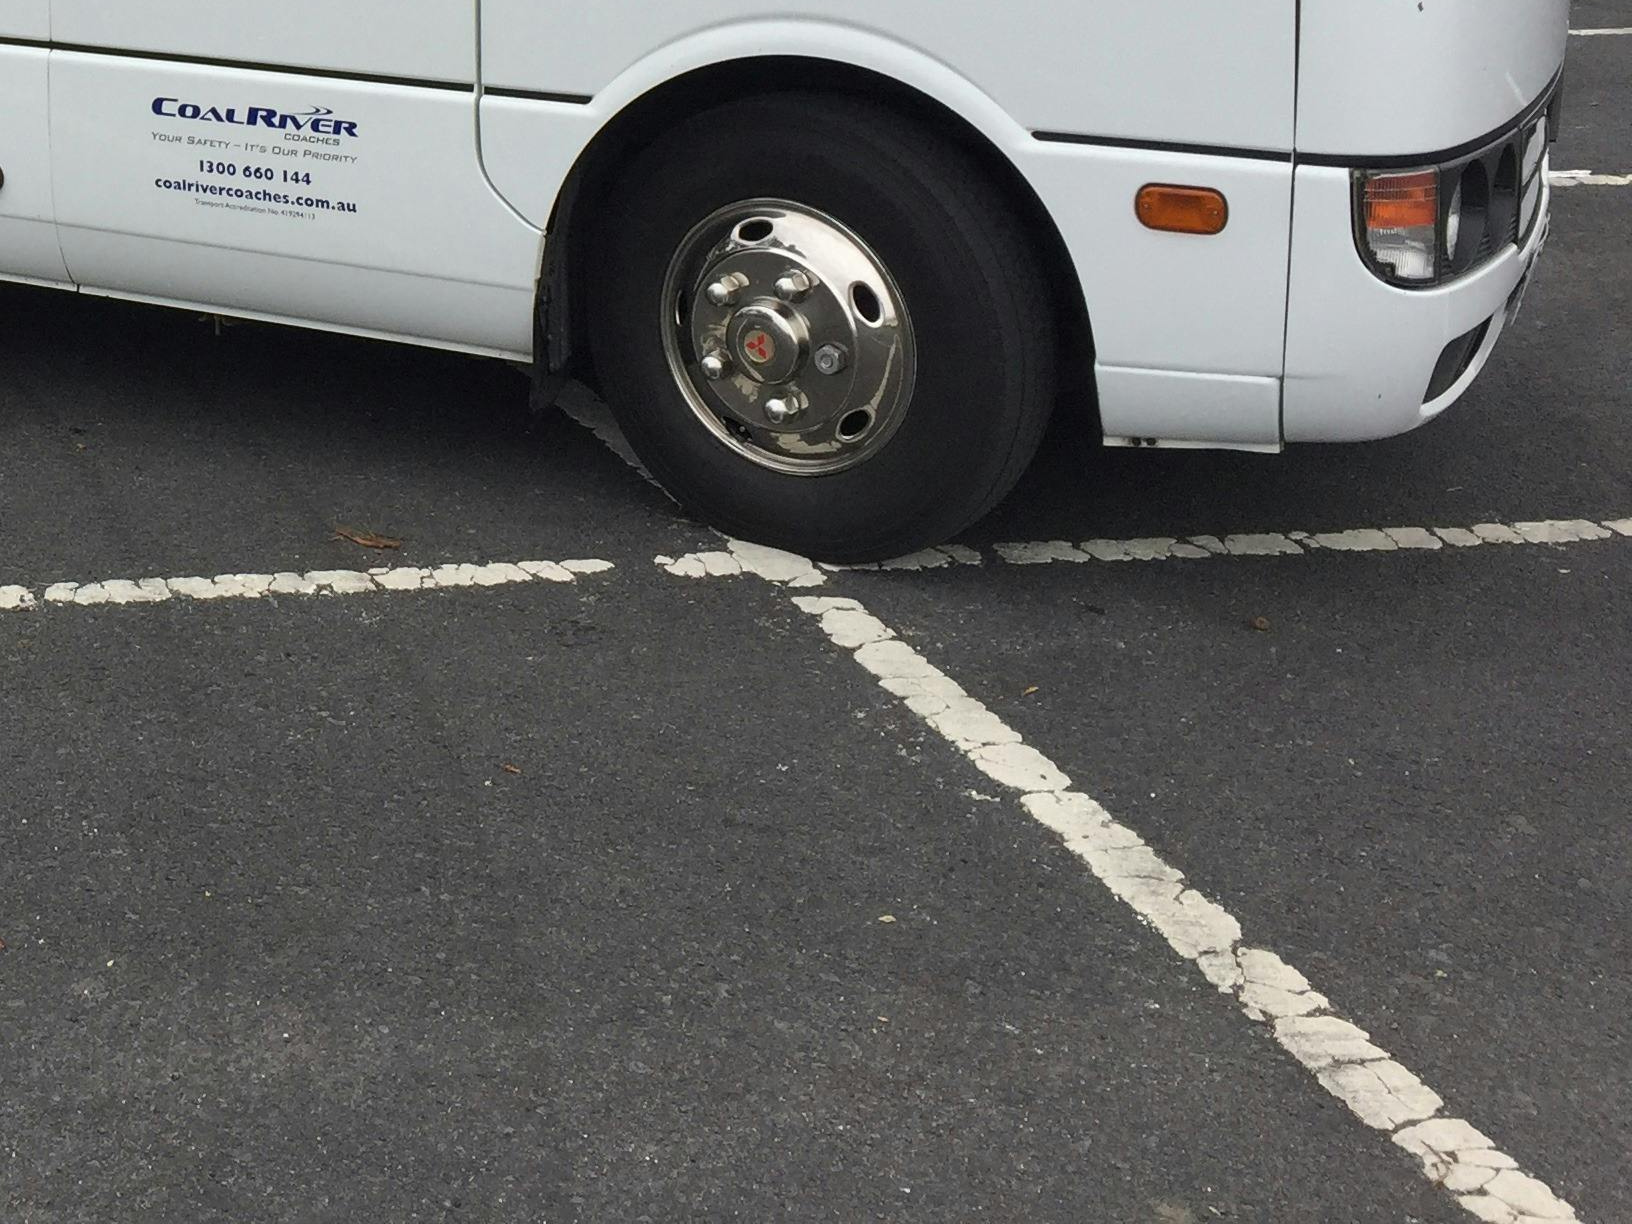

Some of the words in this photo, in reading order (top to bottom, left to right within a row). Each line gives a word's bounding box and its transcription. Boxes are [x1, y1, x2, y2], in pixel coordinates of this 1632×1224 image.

[151, 131, 183, 145] YOUR
[186, 136, 230, 150] SAFETY
[272, 146, 298, 158] OUR
[303, 149, 358, 164] PRIORITY
[284, 132, 340, 147] COACHES
[199, 160, 236, 176] 1300
[242, 165, 274, 180] 660
[282, 170, 312, 186] 144
[155, 177, 357, 213] coalrivercoaches.com.au
